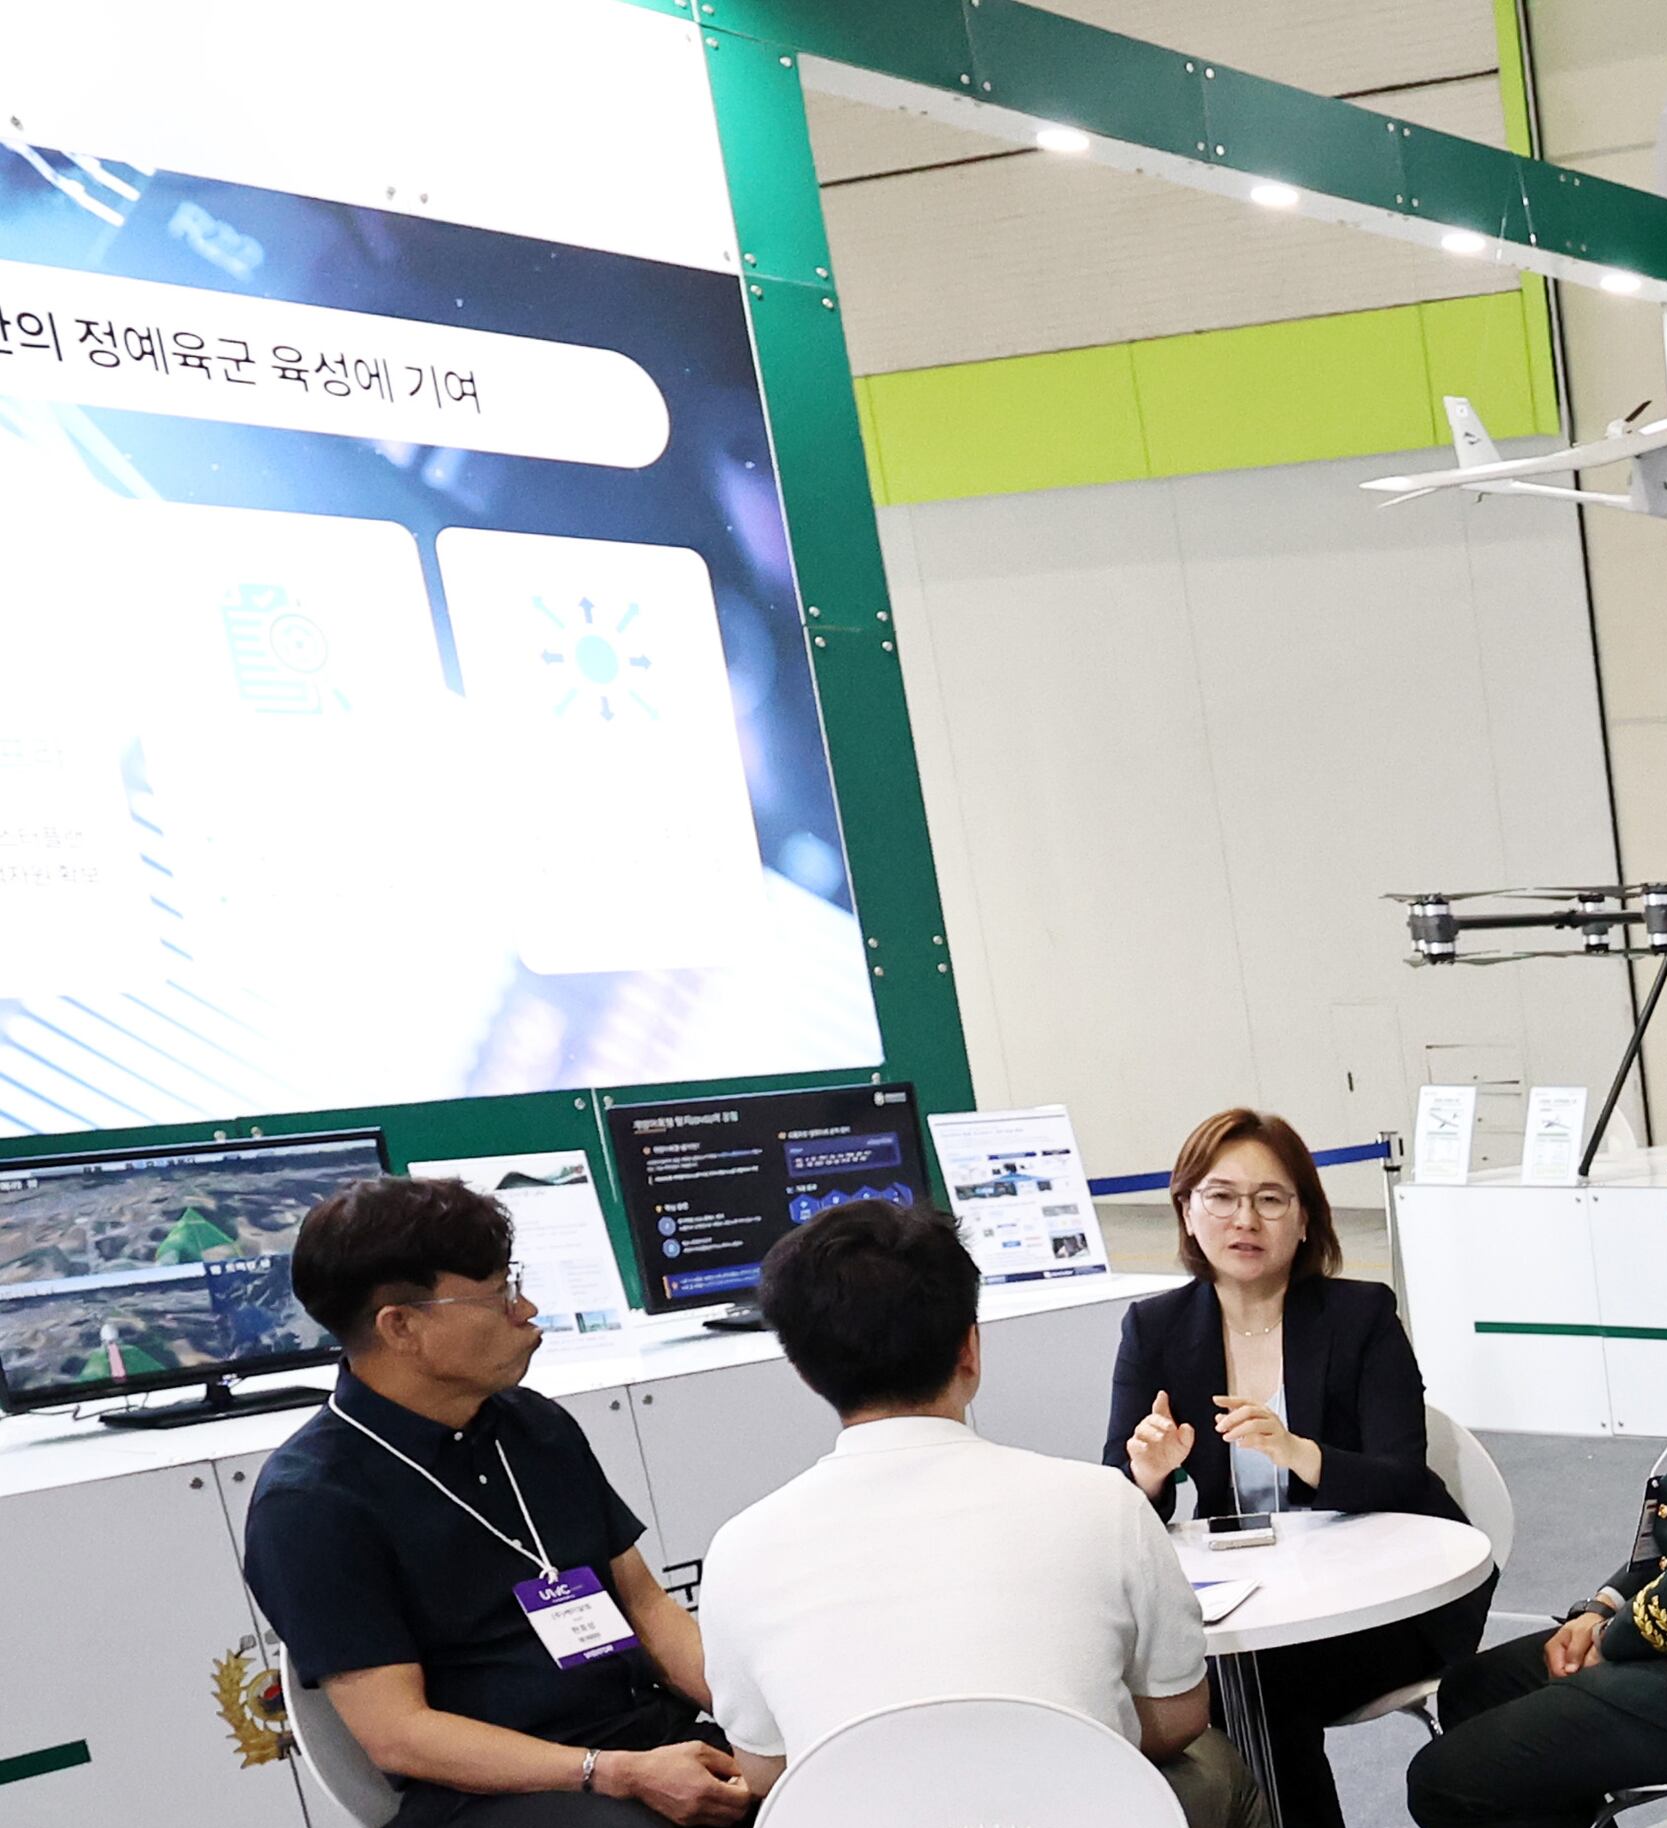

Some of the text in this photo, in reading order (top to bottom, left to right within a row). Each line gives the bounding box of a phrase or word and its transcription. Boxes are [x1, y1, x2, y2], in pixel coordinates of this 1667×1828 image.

[74, 317, 256, 386] 정예육군
[270, 344, 395, 403] 육성에
[405, 364, 482, 414] 기여
